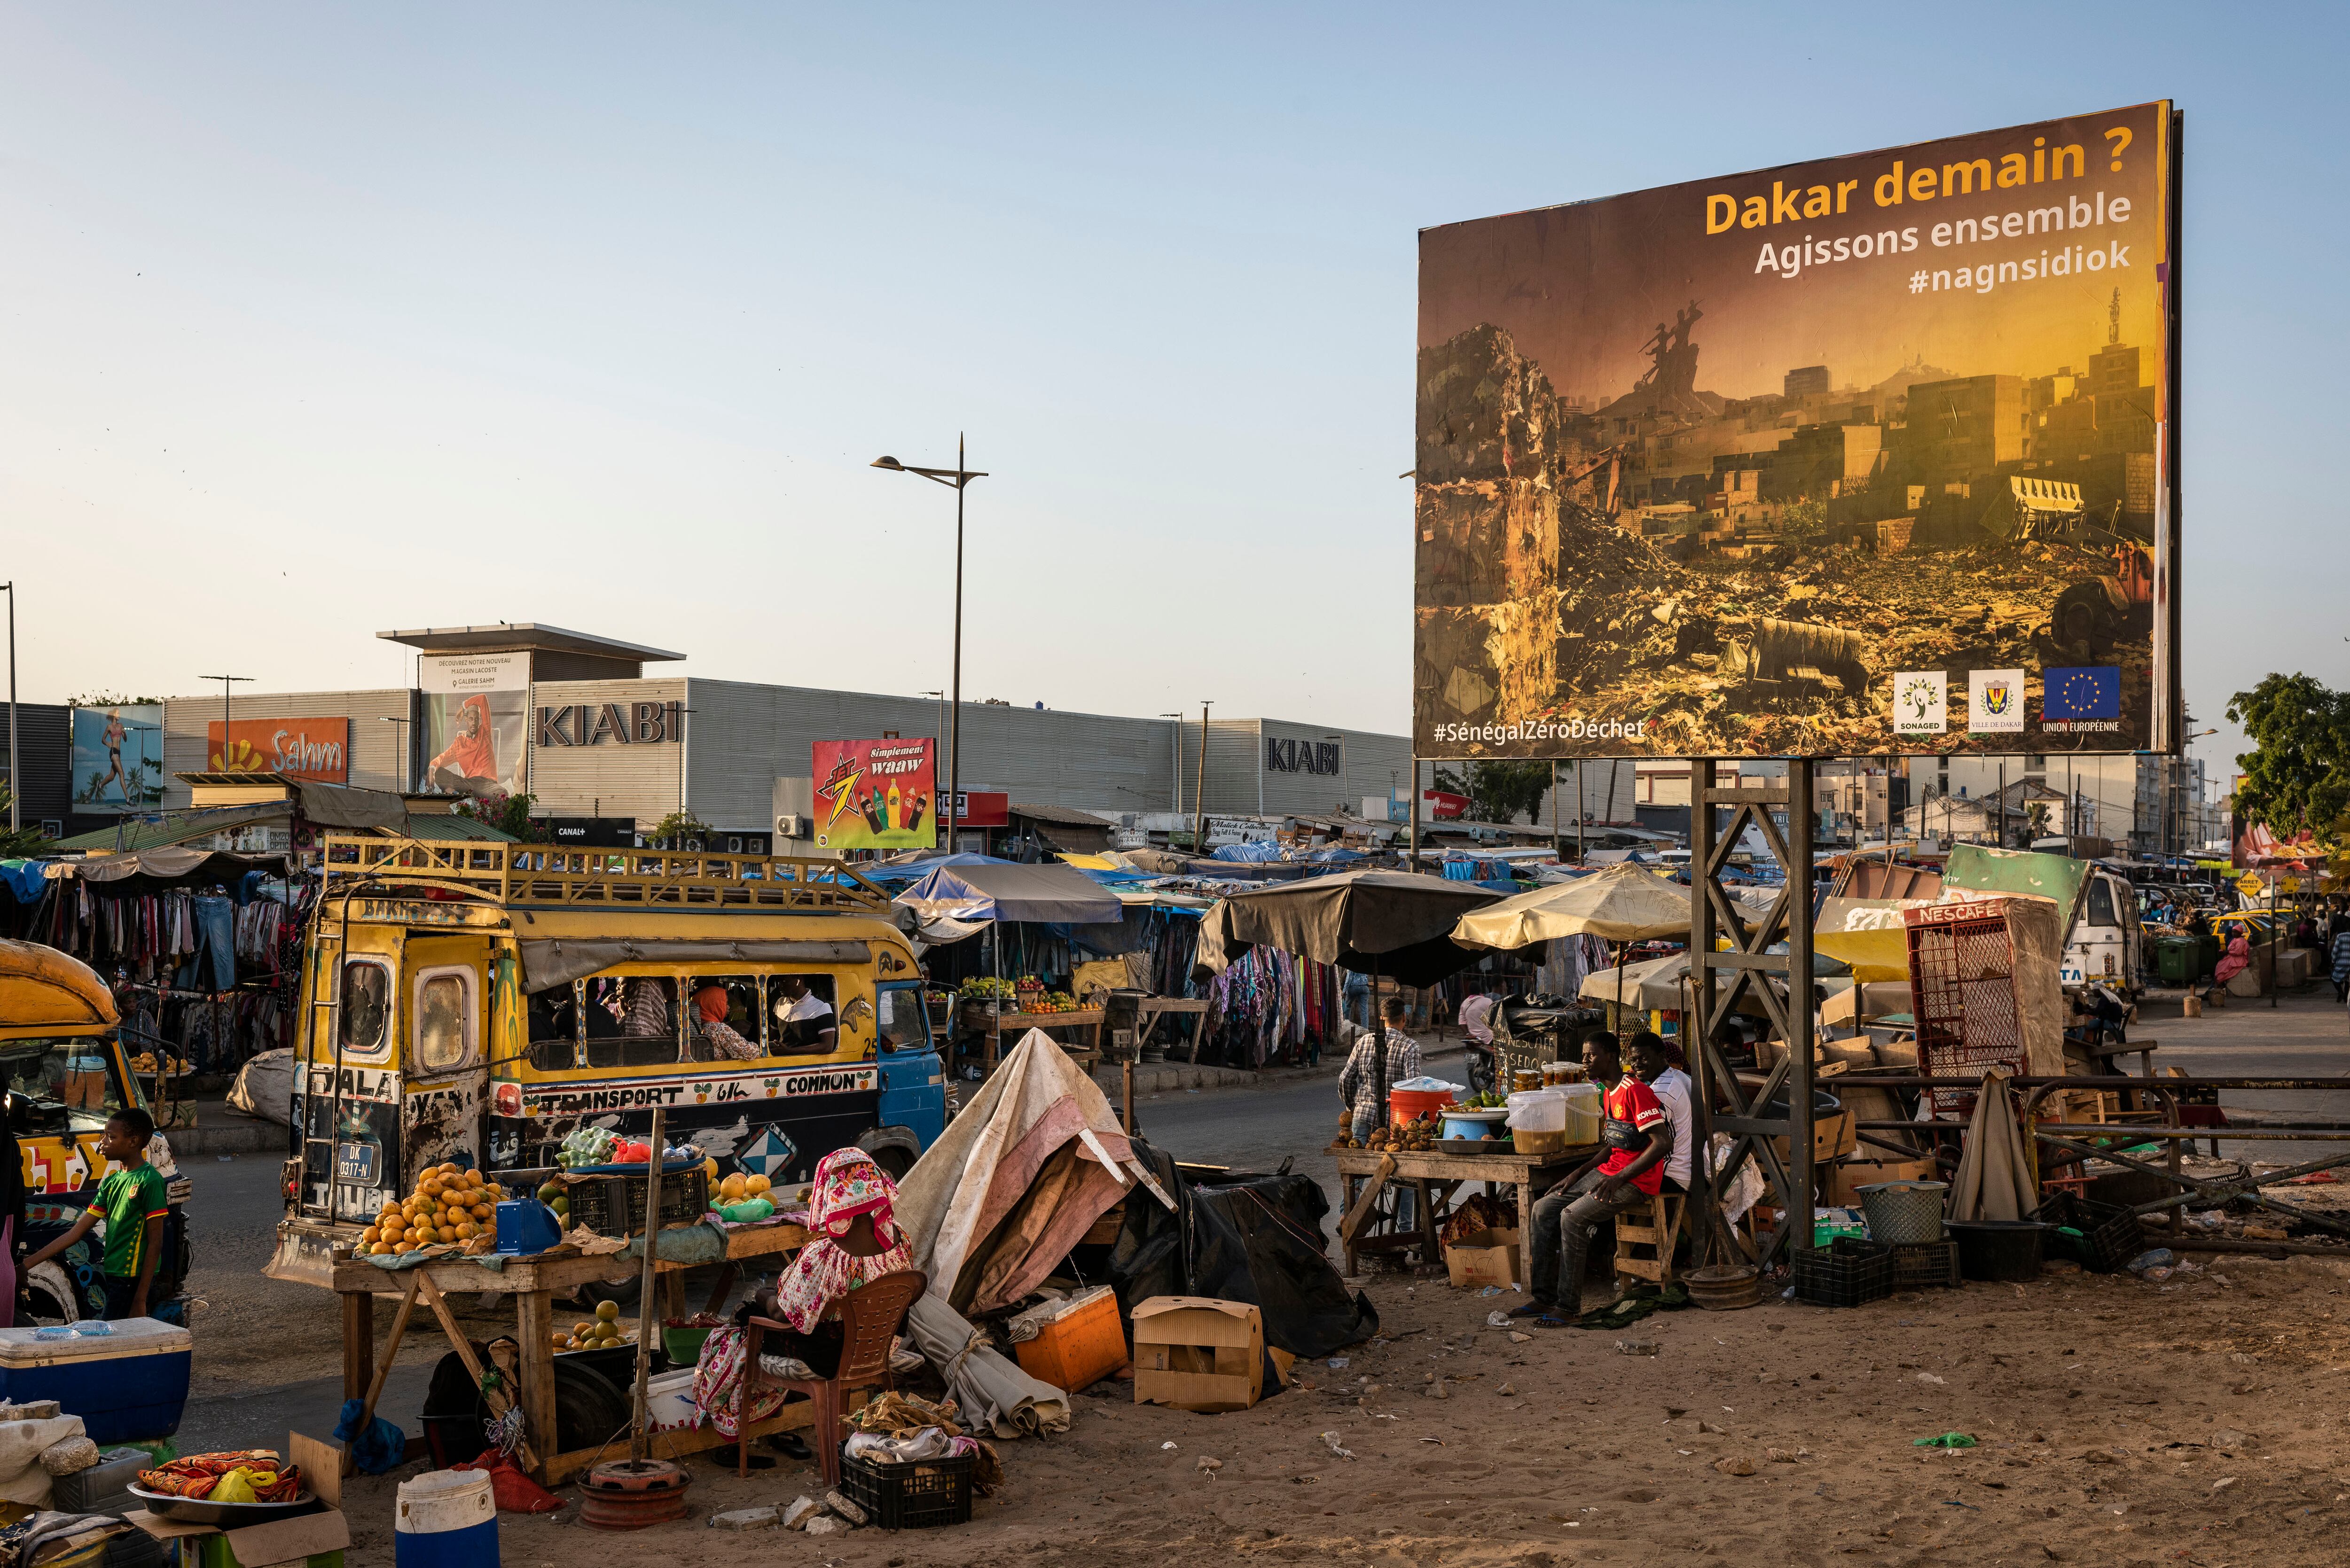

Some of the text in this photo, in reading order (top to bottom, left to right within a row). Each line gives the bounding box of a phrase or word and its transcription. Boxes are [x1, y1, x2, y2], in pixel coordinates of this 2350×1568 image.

[1707, 126, 2133, 235] Dakar demain ?
[1754, 191, 2131, 278] Agissons ensemble
[1908, 240, 2130, 295] #nagnsidiok
[535, 700, 677, 746] KIABI
[1434, 718, 1645, 746] #SénégalZéroDéchet
[2043, 720, 2119, 732] UNION EUROPÉENNE
[271, 730, 341, 772] Sahm
[870, 745, 924, 758] Simplement
[1270, 737, 1339, 775] KIABI
[826, 761, 854, 785] JET
[871, 758, 924, 775] waaw
[540, 1087, 684, 1112] TRANSPORT
[1637, 1108, 1660, 1121] KOHLER
[350, 1146, 360, 1160] DK
[340, 1162, 368, 1177] 0317-N
